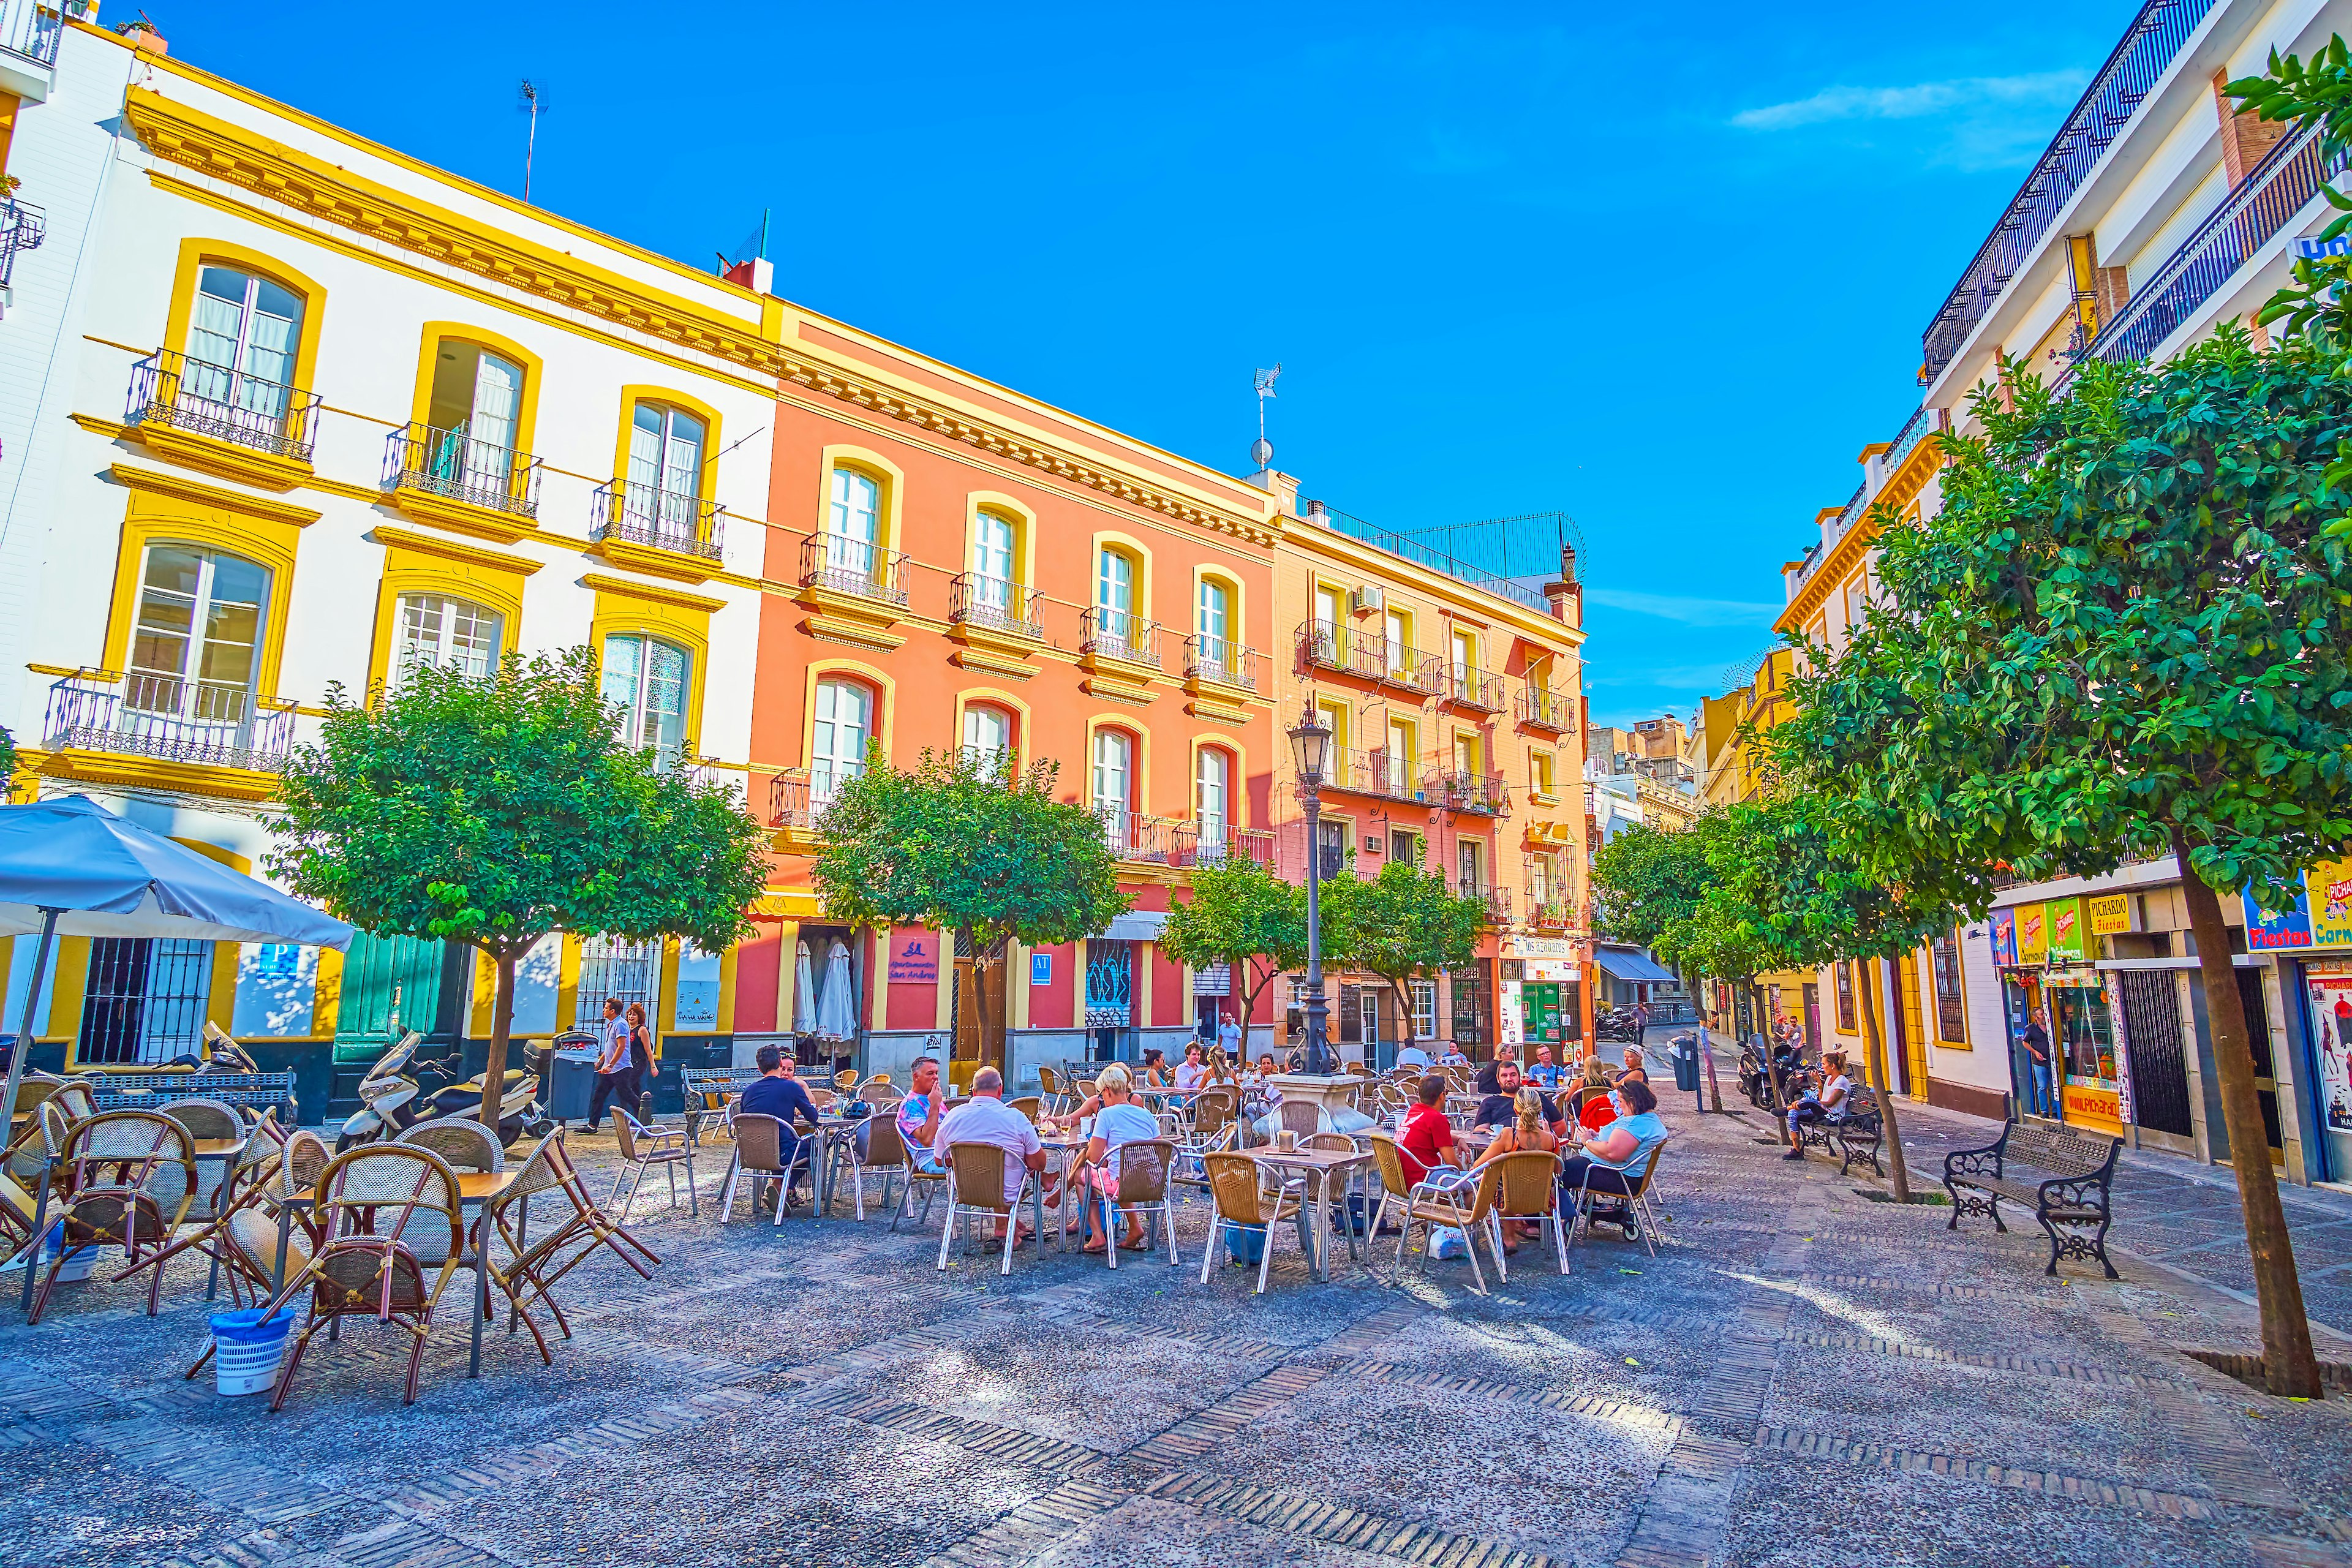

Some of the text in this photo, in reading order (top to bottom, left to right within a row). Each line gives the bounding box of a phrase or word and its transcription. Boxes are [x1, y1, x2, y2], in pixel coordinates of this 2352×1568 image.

[2329, 879, 2352, 899] PICHA
[2091, 898, 2126, 917] PICHARDO
[2056, 912, 2074, 930] PICHARDO
[2097, 918, 2124, 931] Fiestas
[2249, 927, 2311, 948] Fiestas
[272, 944, 288, 962] P
[1035, 957, 1049, 969] AT
[890, 970, 906, 979] San
[2340, 1117, 2352, 1126] HA
